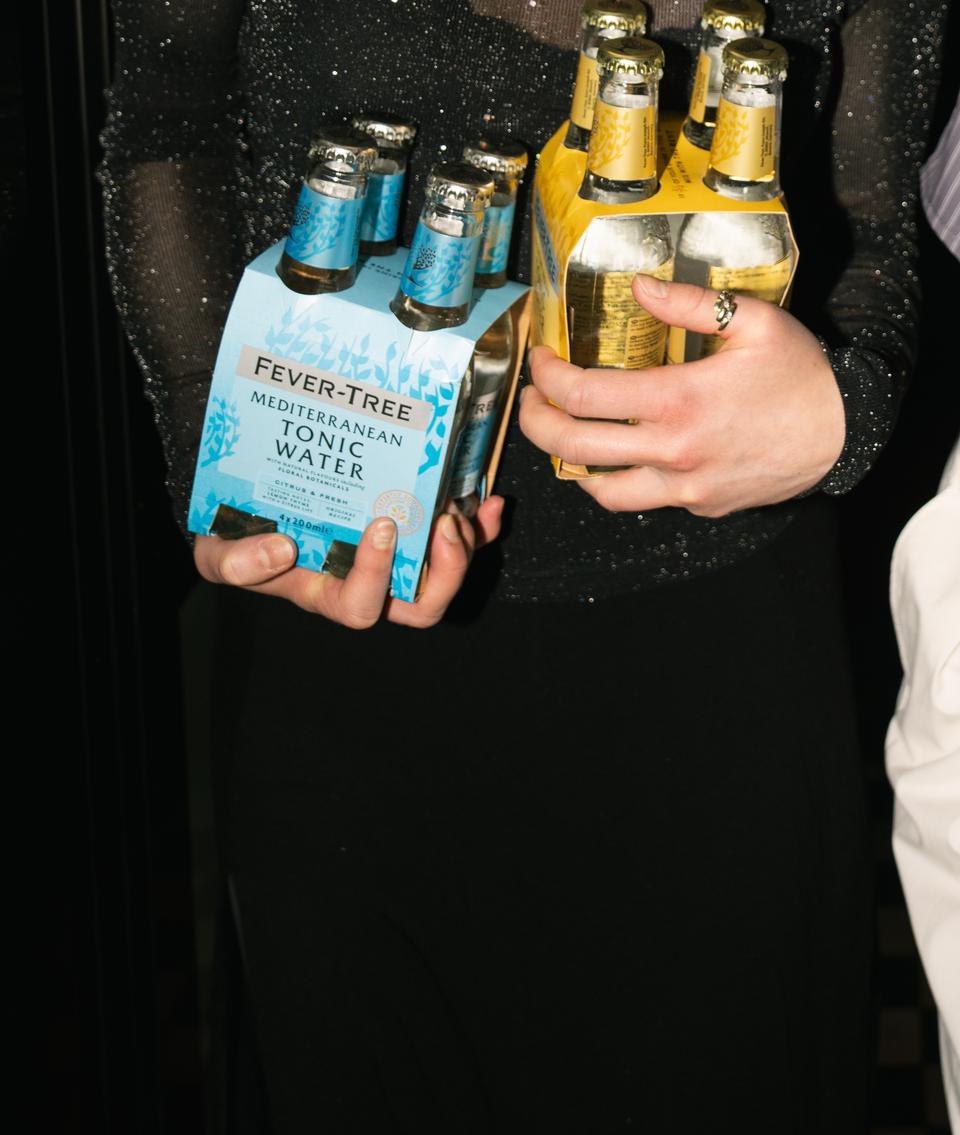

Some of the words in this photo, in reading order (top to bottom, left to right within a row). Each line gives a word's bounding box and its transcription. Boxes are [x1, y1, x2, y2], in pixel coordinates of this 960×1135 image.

[254, 356, 412, 421] FEVER-TREE
[250, 391, 403, 447] MEDITERRANEAN
[281, 419, 365, 458] TONIC
[275, 439, 365, 481] WATER
[274, 479, 306, 493] CITRUS
[319, 493, 348, 505] FRESH
[306, 475, 350, 492] BOTANICALS
